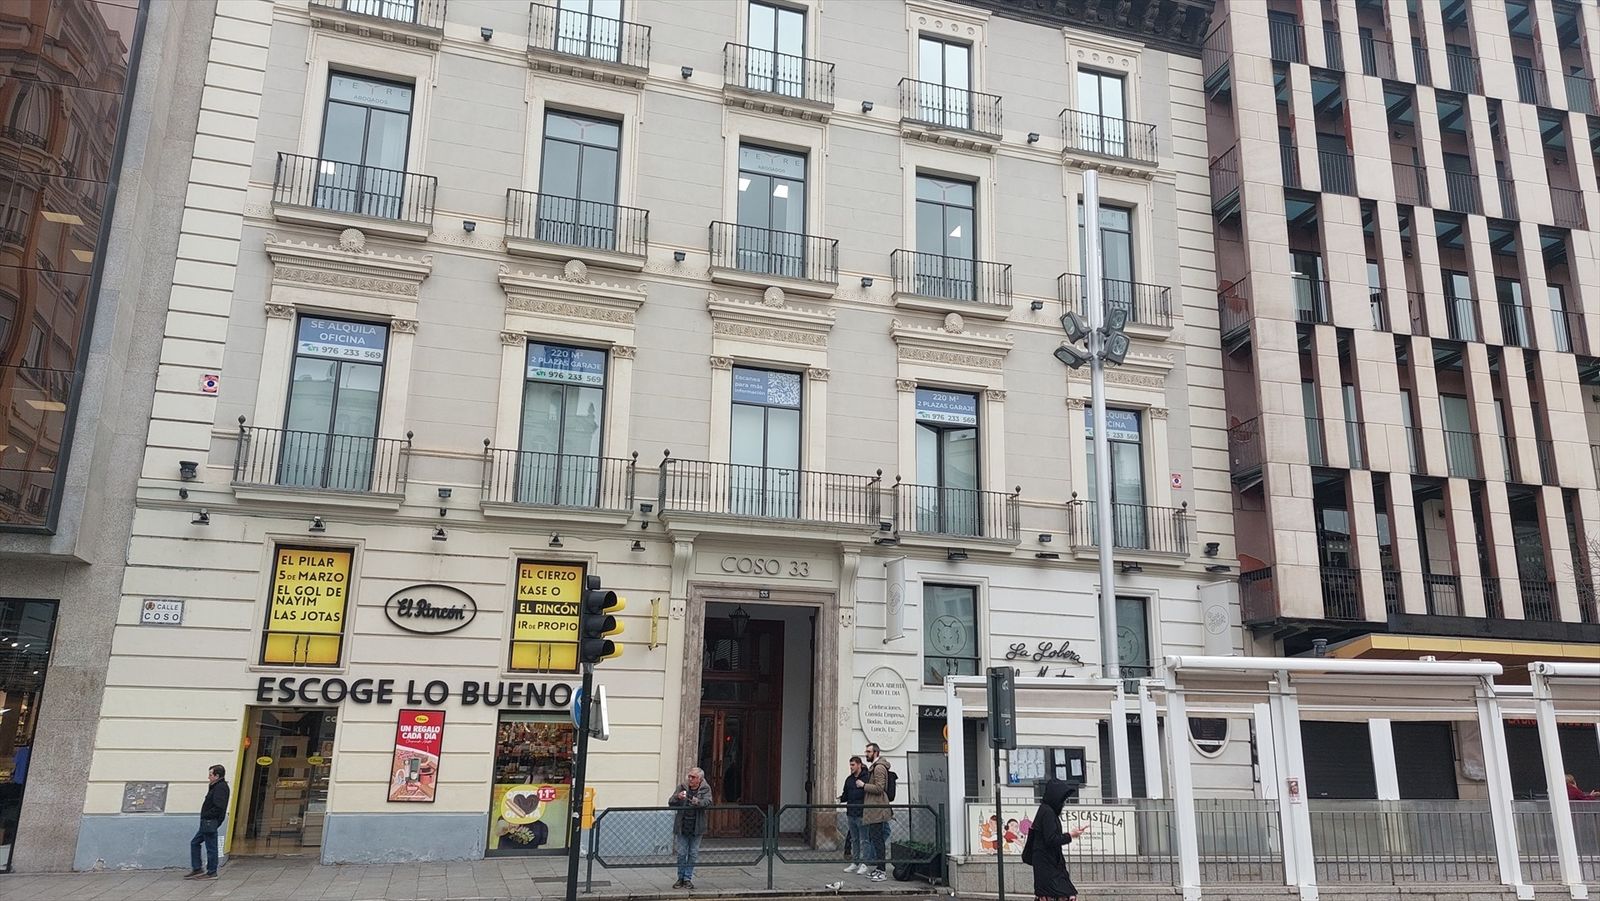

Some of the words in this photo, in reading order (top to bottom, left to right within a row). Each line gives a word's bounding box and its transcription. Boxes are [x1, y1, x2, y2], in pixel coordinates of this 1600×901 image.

[310, 320, 325, 329] SE
[328, 322, 376, 335] ALQUILA
[320, 332, 366, 345] OFICINA
[322, 346, 339, 354] 976
[551, 349, 568, 357] 220
[538, 358, 569, 366] PLAZAS
[570, 360, 601, 370] GARAJE
[1108, 421, 1126, 429] CINA
[281, 555, 294, 565] EL
[298, 556, 334, 567] PILAR
[720, 556, 781, 575] COSO
[789, 560, 810, 577] 33
[279, 570, 286, 580] 5
[298, 571, 344, 582] MARZO
[522, 569, 533, 578] EL
[537, 570, 576, 581] CIERZO
[277, 585, 290, 595] EL
[295, 586, 321, 596] GOL
[326, 587, 342, 597] DE
[520, 586, 547, 595] KASE
[551, 587, 561, 596] O
[276, 596, 317, 606] NAYIM
[397, 598, 414, 618] El
[414, 598, 466, 620] Rincón
[520, 603, 532, 613] EL
[535, 602, 578, 614] RINCÓN
[144, 612, 179, 621] COSO
[274, 610, 296, 620] LAS
[300, 611, 340, 622] JOTAS
[518, 621, 528, 629] IR
[537, 621, 578, 631] PROPIO
[1006, 642, 1031, 660] La
[1033, 640, 1085, 667] Lobera
[255, 676, 394, 704] ESCOGE
[406, 679, 449, 705] LO
[461, 681, 573, 707] BUENO
[924, 708, 933, 717] La
[1080, 811, 1123, 828] CASTILLA
